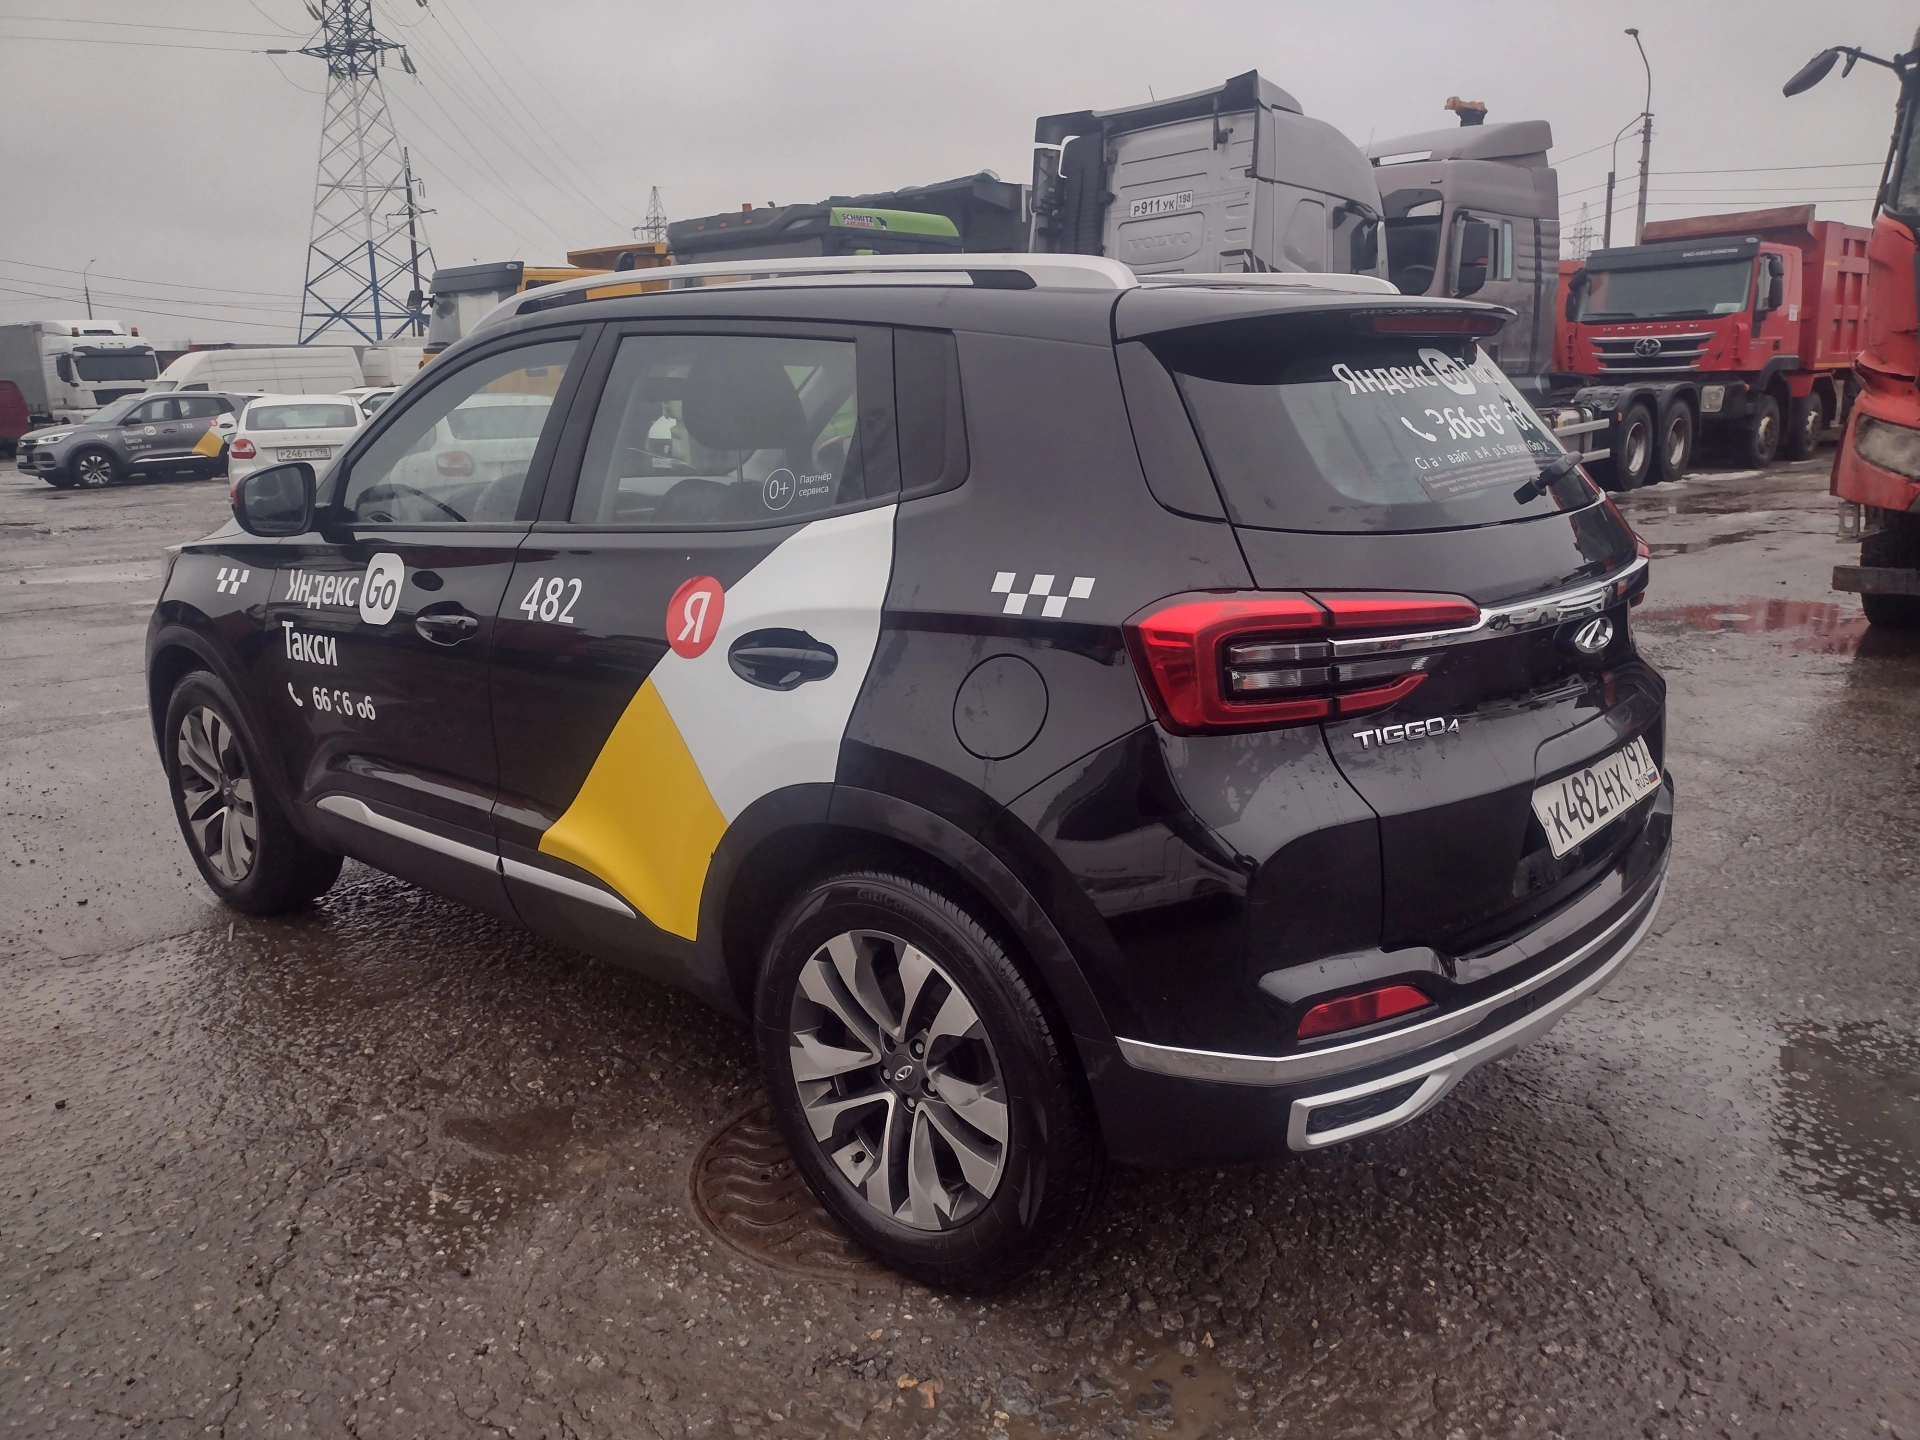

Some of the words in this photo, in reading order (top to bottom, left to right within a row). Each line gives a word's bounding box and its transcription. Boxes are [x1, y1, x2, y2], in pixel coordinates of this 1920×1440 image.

[1178, 193, 1192, 204] 198
[842, 213, 873, 223] SCHMITZ
[1127, 231, 1192, 251] VOLVO
[1331, 363, 1439, 395] Яндекс
[799, 472, 832, 485] Партнёр
[769, 479, 790, 500] 0+
[798, 485, 829, 497] сервиса
[285, 568, 360, 610] Яндекс
[519, 576, 583, 624] 482
[677, 591, 712, 643] Я
[282, 620, 338, 667] Такси
[1634, 773, 1650, 791] RUS
[1547, 764, 1632, 844] К482НХ
